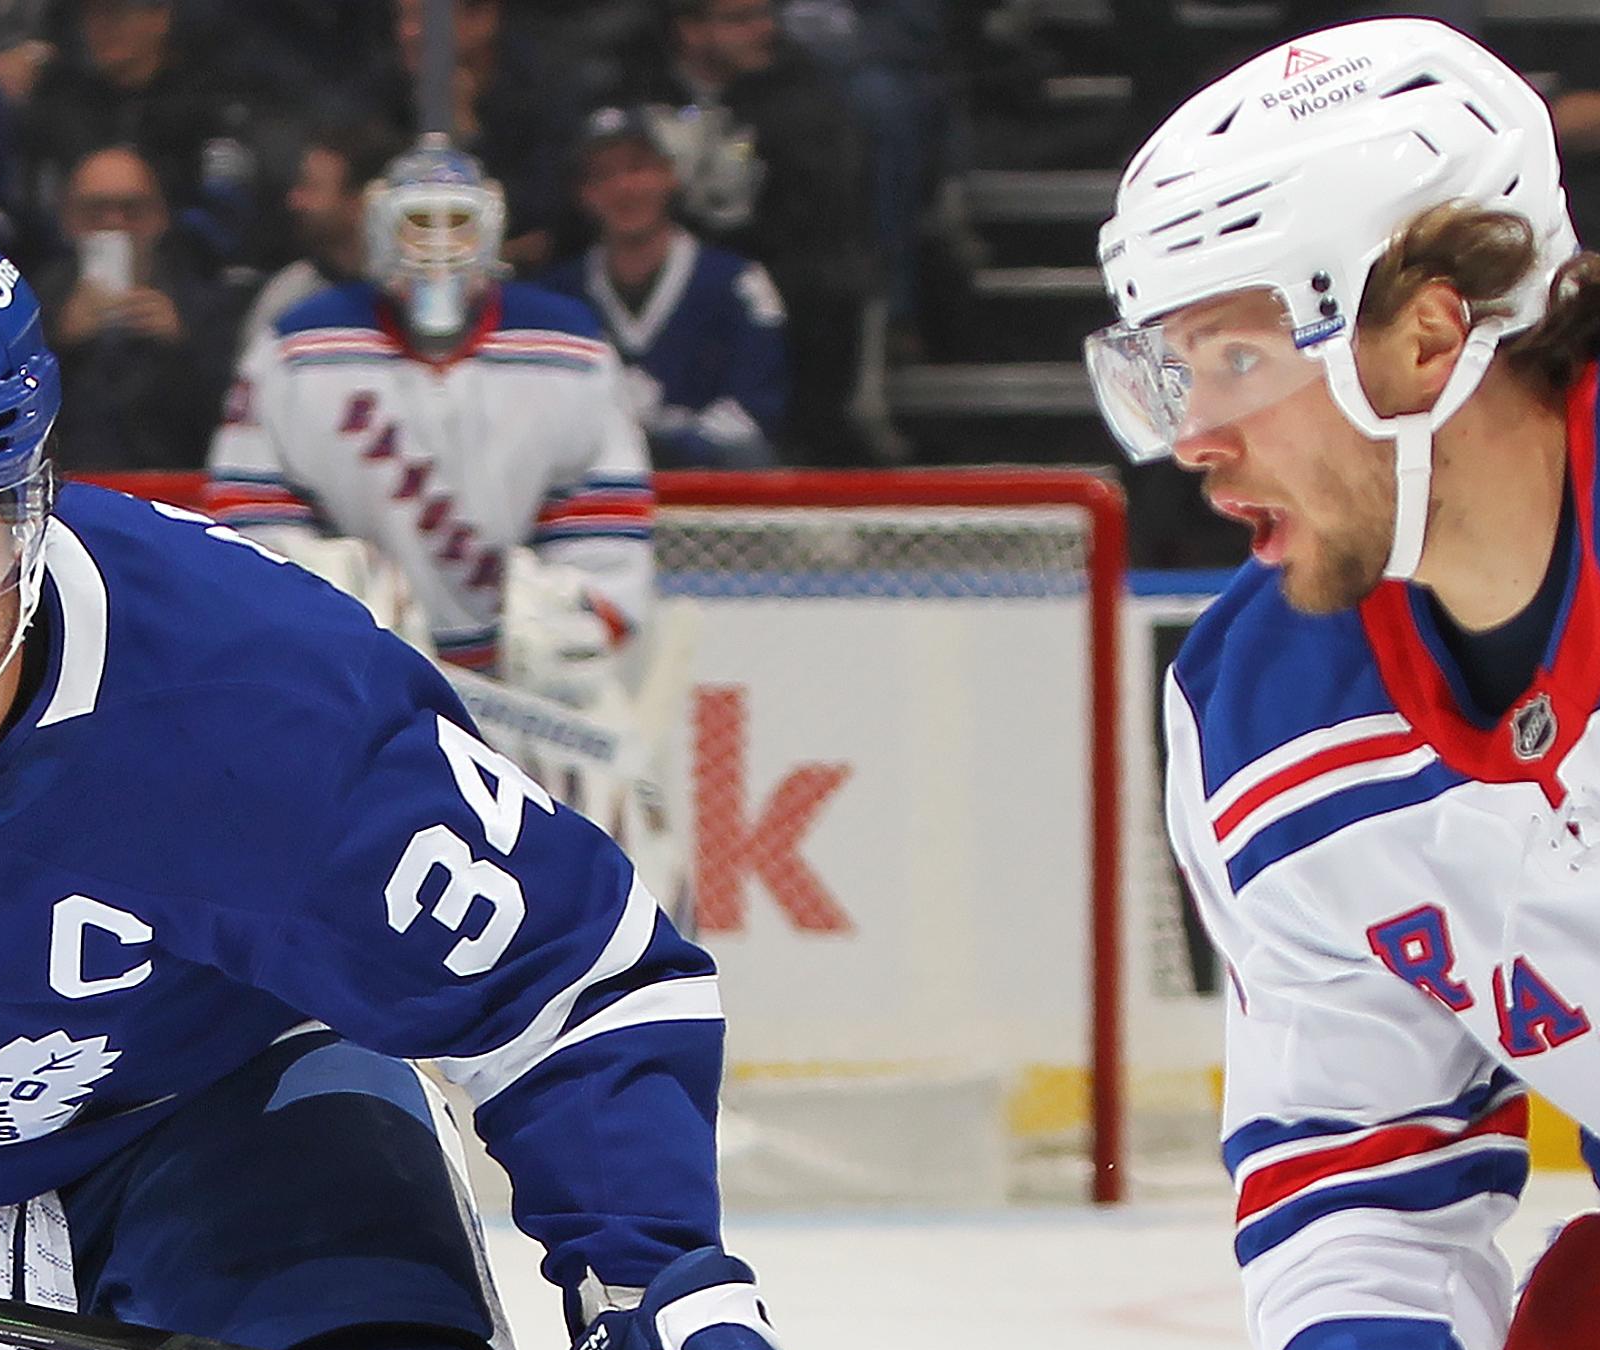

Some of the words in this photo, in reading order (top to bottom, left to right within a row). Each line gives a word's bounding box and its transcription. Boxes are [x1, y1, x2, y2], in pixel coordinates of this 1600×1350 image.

[1260, 56, 1372, 109] Benjamin
[1288, 79, 1367, 120] Moore
[384, 713, 556, 978] 34
[48, 894, 154, 1000] C
